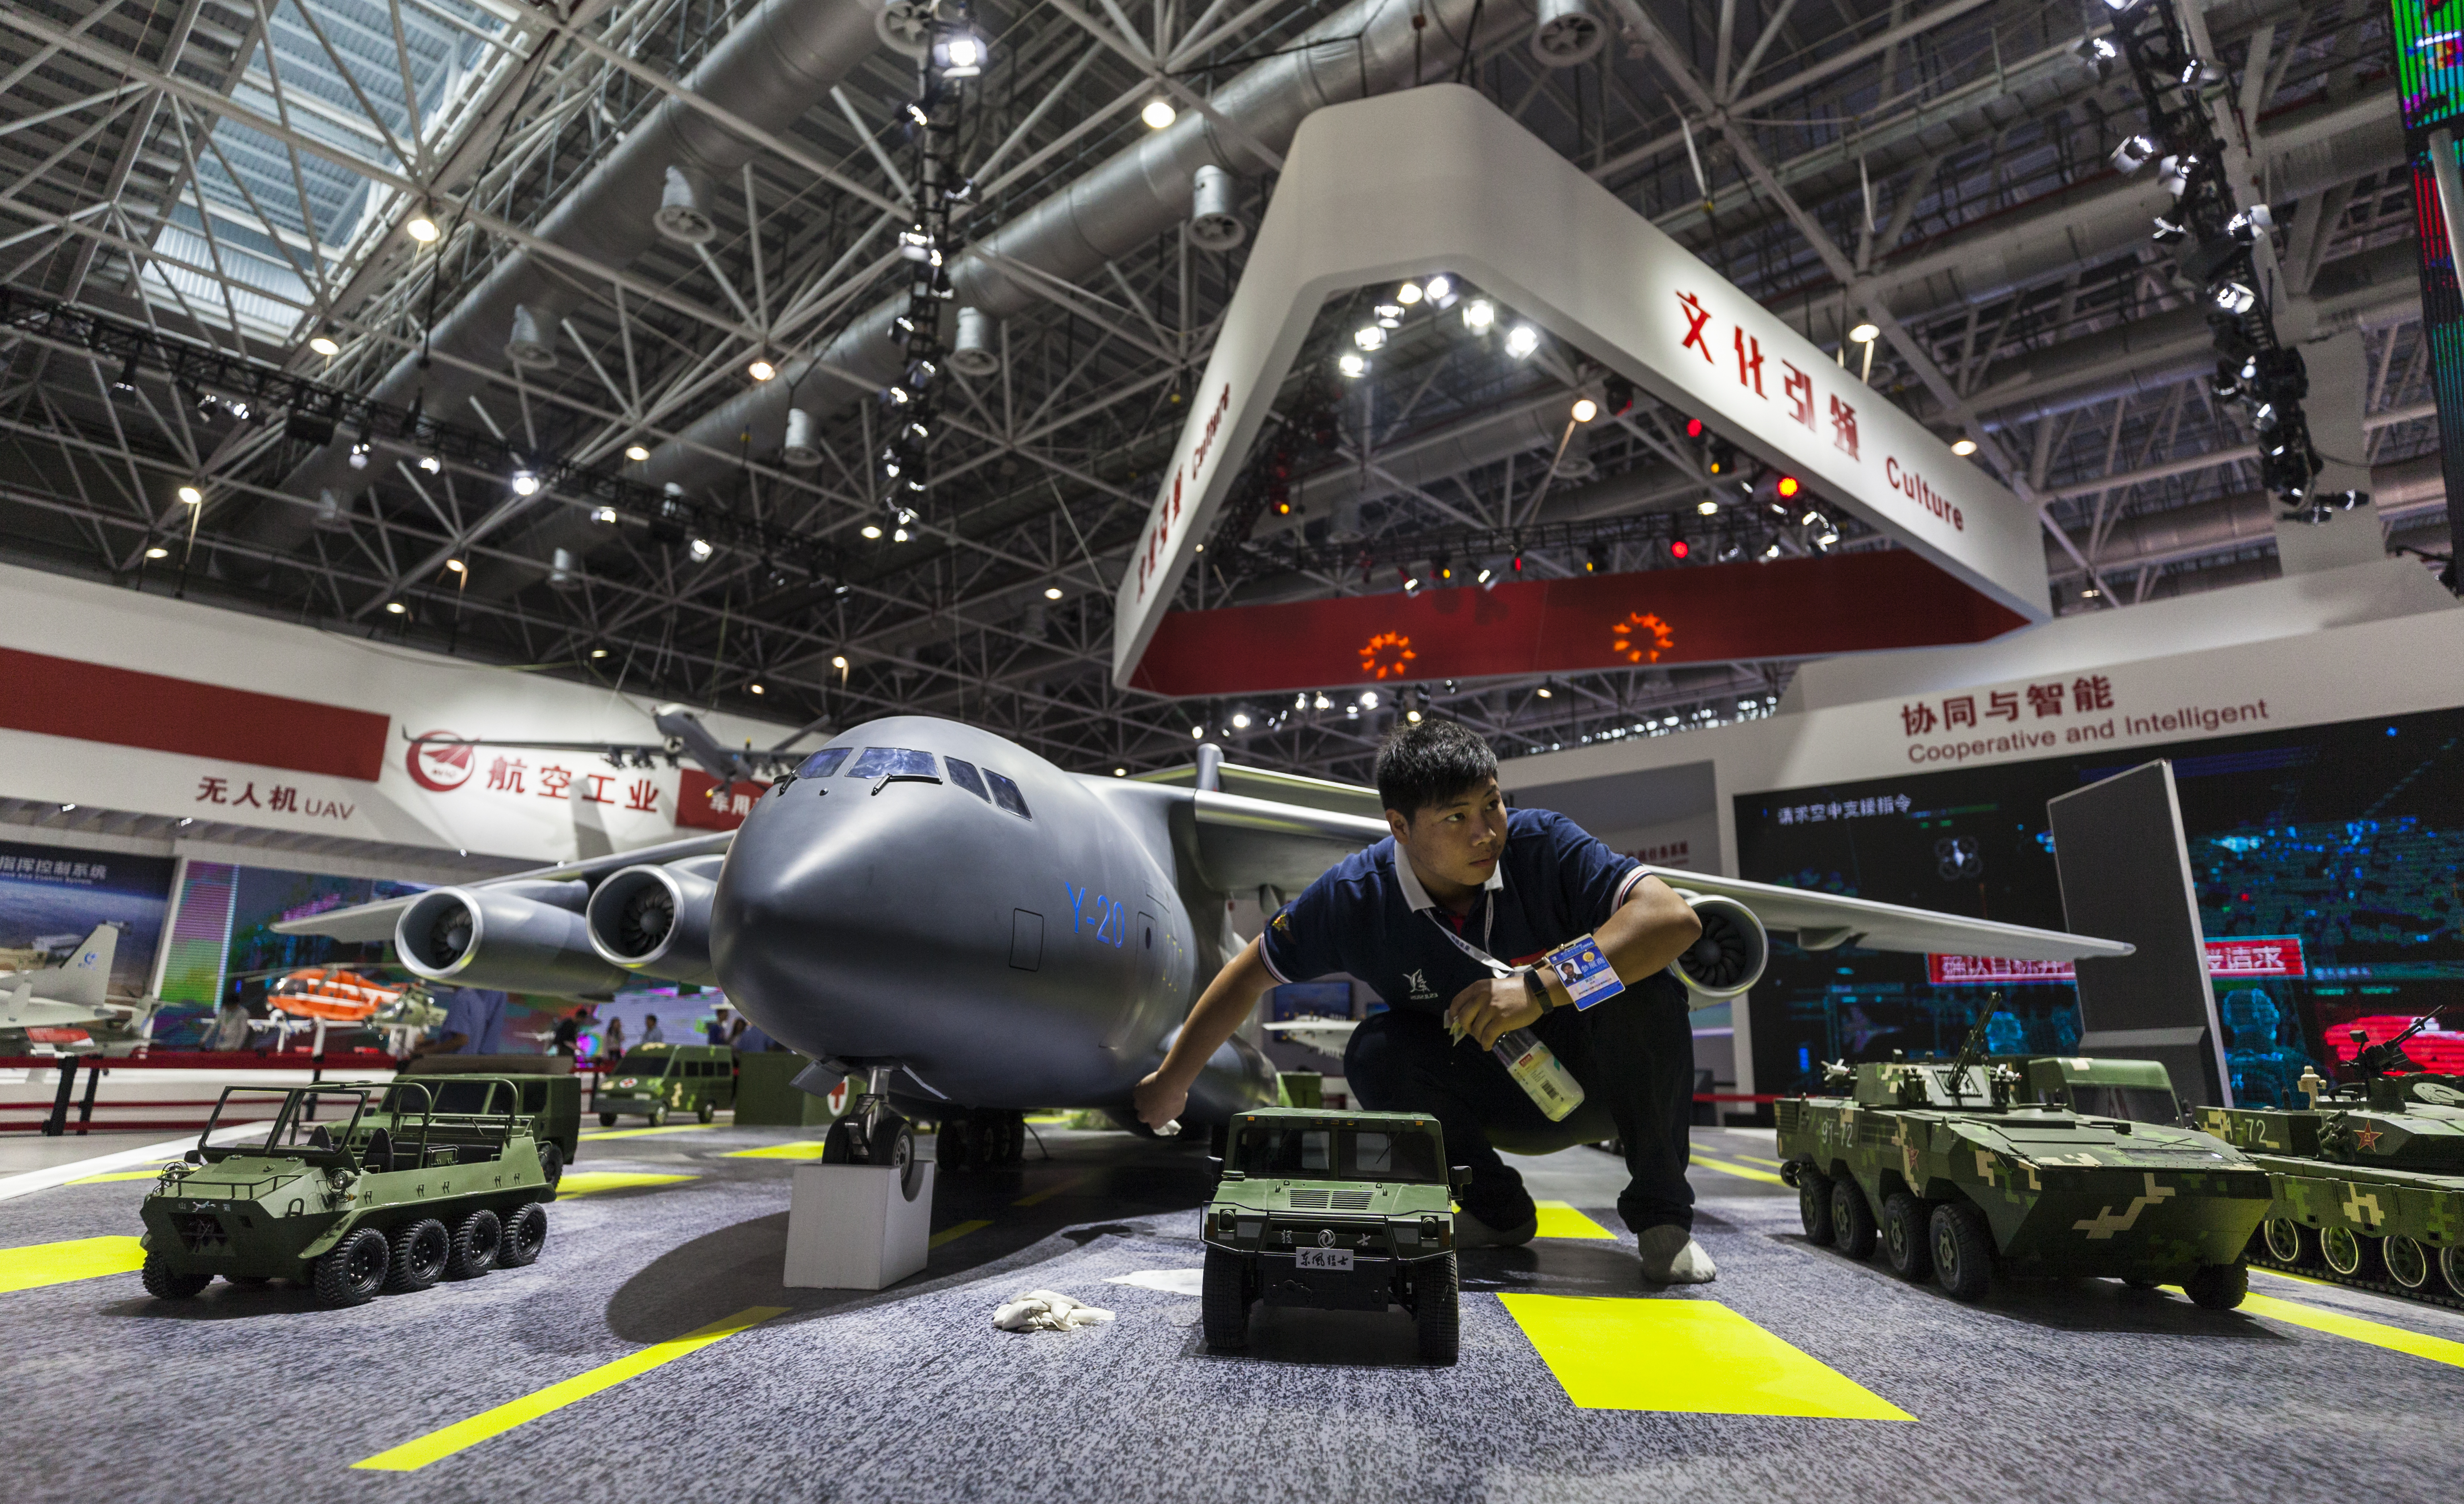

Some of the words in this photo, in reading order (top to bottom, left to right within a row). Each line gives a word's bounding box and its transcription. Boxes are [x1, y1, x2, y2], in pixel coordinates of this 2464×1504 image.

[1675, 289, 1860, 462] 文化引领
[1193, 382, 1230, 481] Culture
[1885, 456, 1964, 531] Culture
[1901, 674, 2115, 738] 协同与智能
[1908, 730, 2056, 763] Cooperative
[2066, 717, 2115, 744] and
[2125, 698, 2270, 736] Intelligent
[196, 776, 298, 813] 无人机
[304, 798, 356, 820] UAV
[487, 755, 659, 812] 航空工业
[708, 791, 762, 816] 军用
[1065, 882, 1125, 949] Y-20
[1942, 955, 2074, 975] 确认目标
[1822, 1121, 1853, 1148] 91-72
